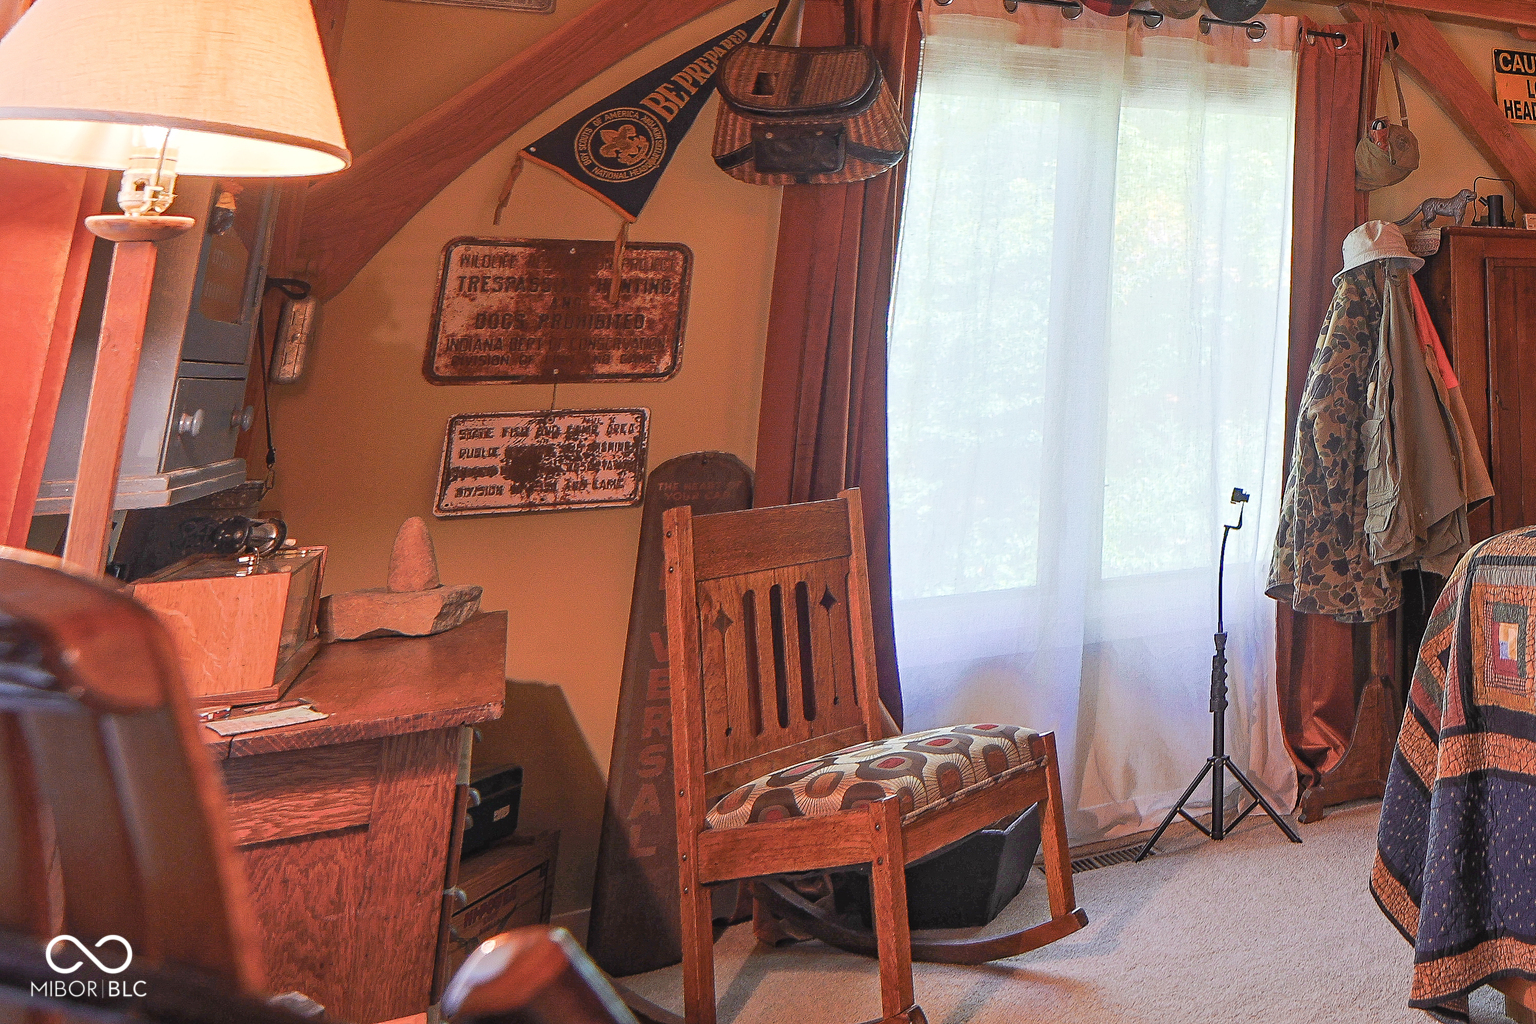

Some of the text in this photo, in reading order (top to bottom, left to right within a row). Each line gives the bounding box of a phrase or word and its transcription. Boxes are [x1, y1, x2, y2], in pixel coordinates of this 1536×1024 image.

[640, 29, 748, 123] BE PREPARED
[578, 110, 639, 166] BOY SCOUTS OF AMERICA
[592, 166, 629, 180] NATIONAL
[459, 254, 518, 268] WILDLIFE
[597, 278, 674, 294] HNTING
[475, 313, 647, 330] DOGS PROHIBITED
[447, 337, 504, 353] INDIANA
[451, 354, 511, 367] DIVISION
